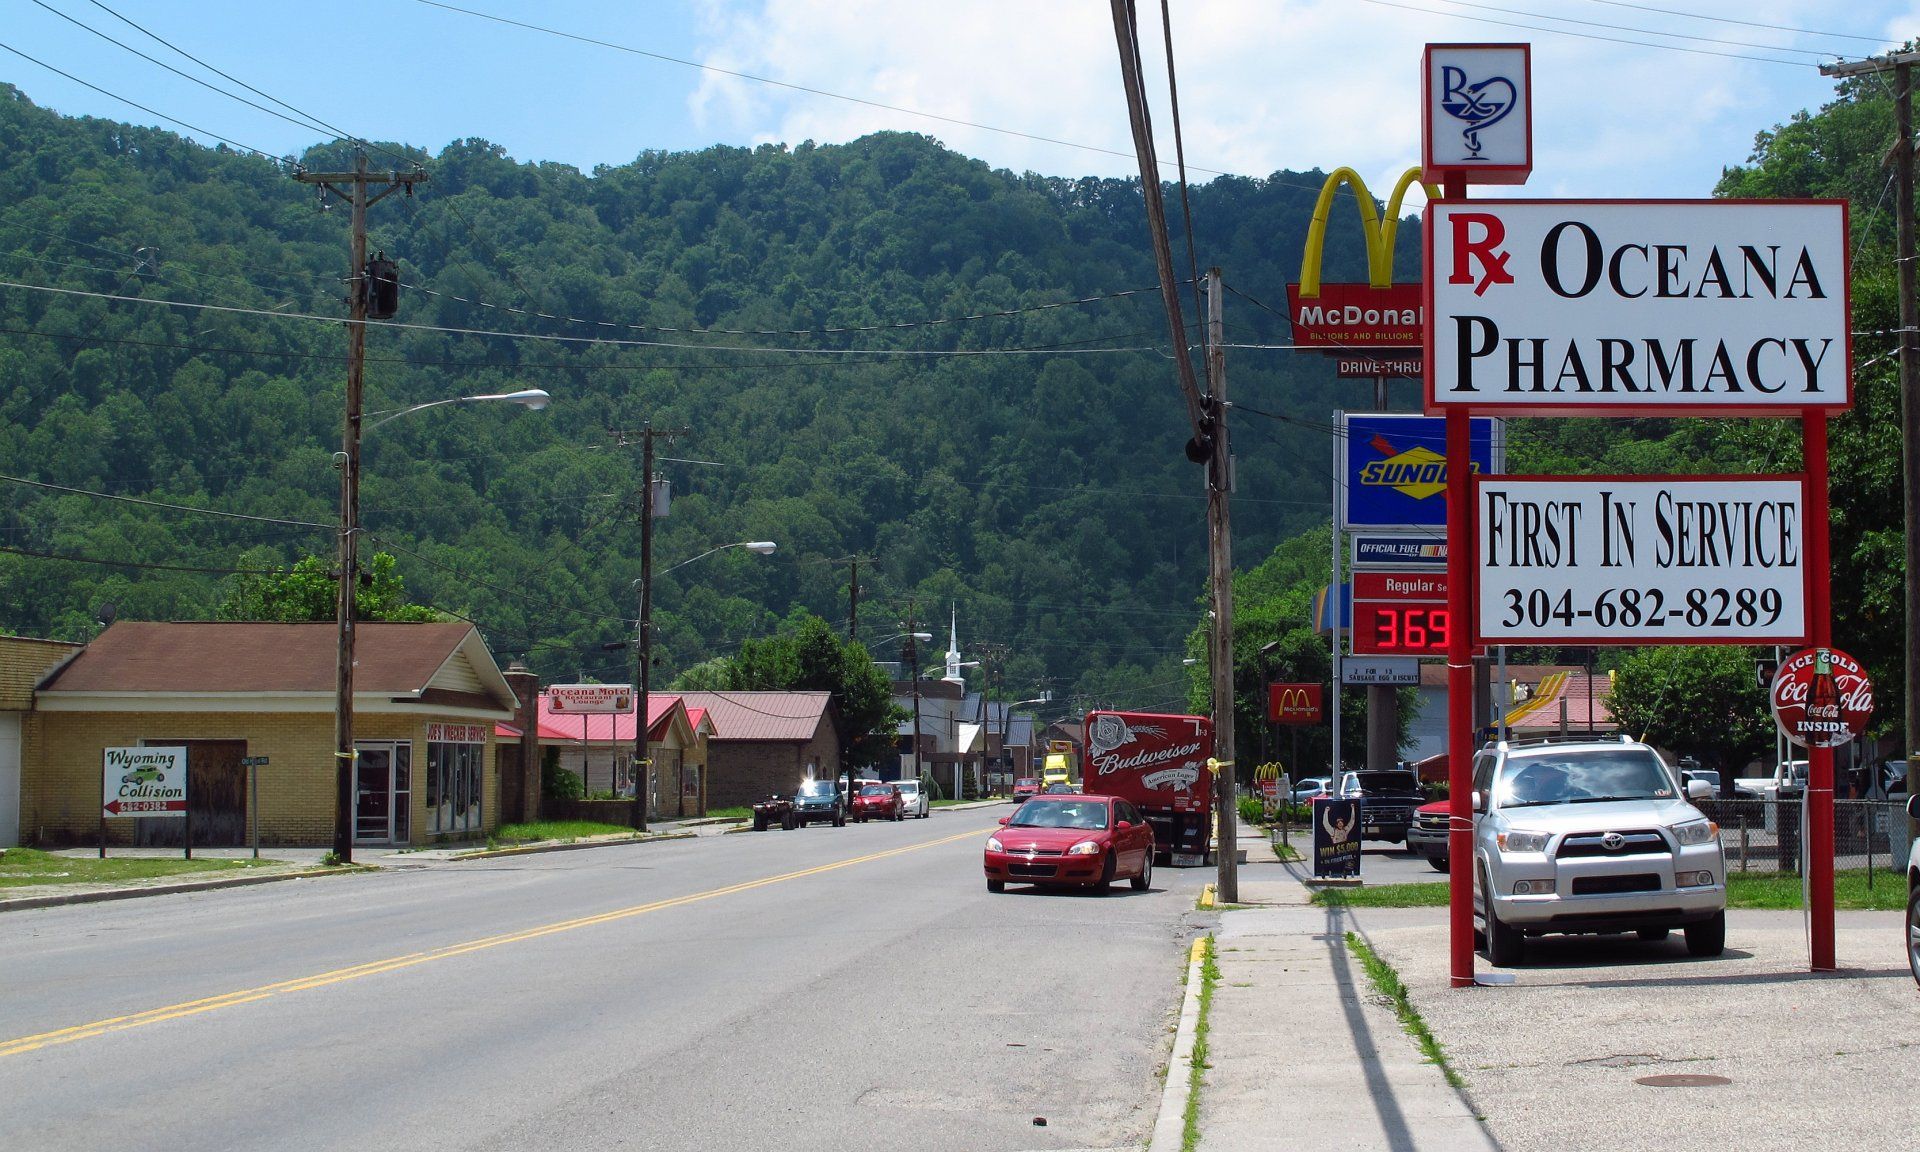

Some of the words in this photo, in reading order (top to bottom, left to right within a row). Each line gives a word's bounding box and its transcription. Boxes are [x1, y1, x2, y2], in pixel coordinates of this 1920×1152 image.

[1541, 221, 1828, 299] OCEANA
[1299, 305, 1424, 326] McDonal
[1353, 332, 1371, 340] AND
[1375, 332, 1414, 340] BILLIONS
[1450, 315, 1834, 394] PHARMACY
[1340, 361, 1422, 373] DRIVE-THRU
[1363, 462, 1478, 484] SUNO
[1486, 491, 1582, 569] FIRST
[1598, 491, 1637, 569] IN
[1655, 489, 1798, 569] SERVICE
[1360, 543, 1397, 554] OFFICIAL
[1399, 543, 1420, 554] FUEL
[1386, 578, 1434, 594] Regular
[1502, 587, 1783, 628] 304-682-8289
[1788, 654, 1814, 672] ICE
[1820, 652, 1859, 673] COLD
[551, 687, 595, 696] Oceana
[598, 687, 630, 696] Motel
[1775, 673, 1808, 702] Coc
[427, 723, 442, 740] JOE'S
[443, 724, 467, 742] WRECKER
[468, 725, 486, 743] SERVICE
[1797, 721, 1849, 732] INSIDE
[107, 750, 176, 769] Wyoming
[1092, 742, 1201, 776] Budweiser
[1147, 772, 1176, 785] American
[1176, 772, 1195, 780] Lager
[119, 784, 183, 798] Collision
[119, 801, 168, 812] 682-0382
[1320, 846, 1335, 858] WIN
